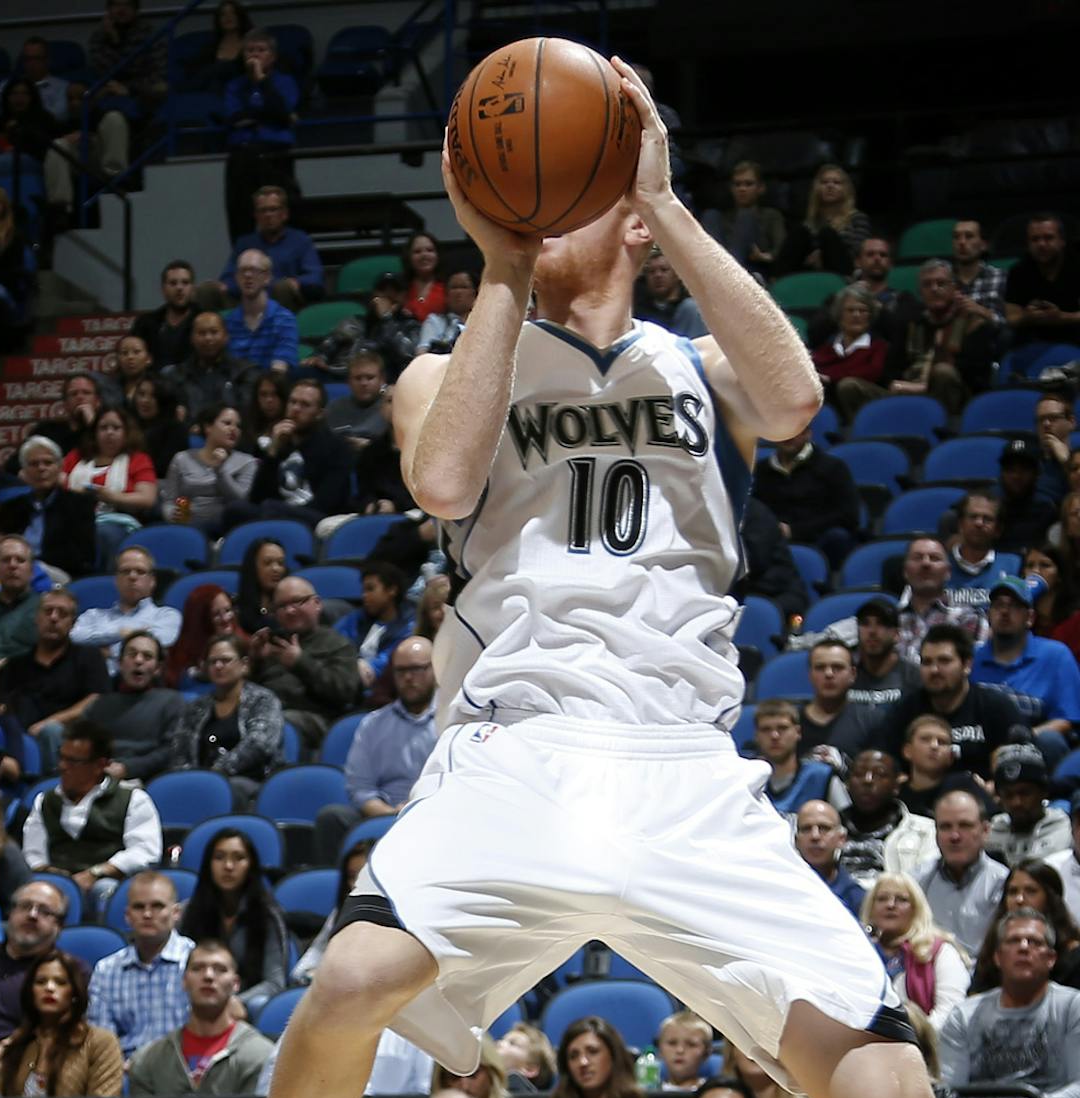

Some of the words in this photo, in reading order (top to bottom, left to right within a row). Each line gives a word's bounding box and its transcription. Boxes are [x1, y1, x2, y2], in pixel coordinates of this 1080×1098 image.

[30, 356, 103, 377] TARGET
[506, 391, 709, 471] WOLVES
[566, 457, 651, 558] 10
